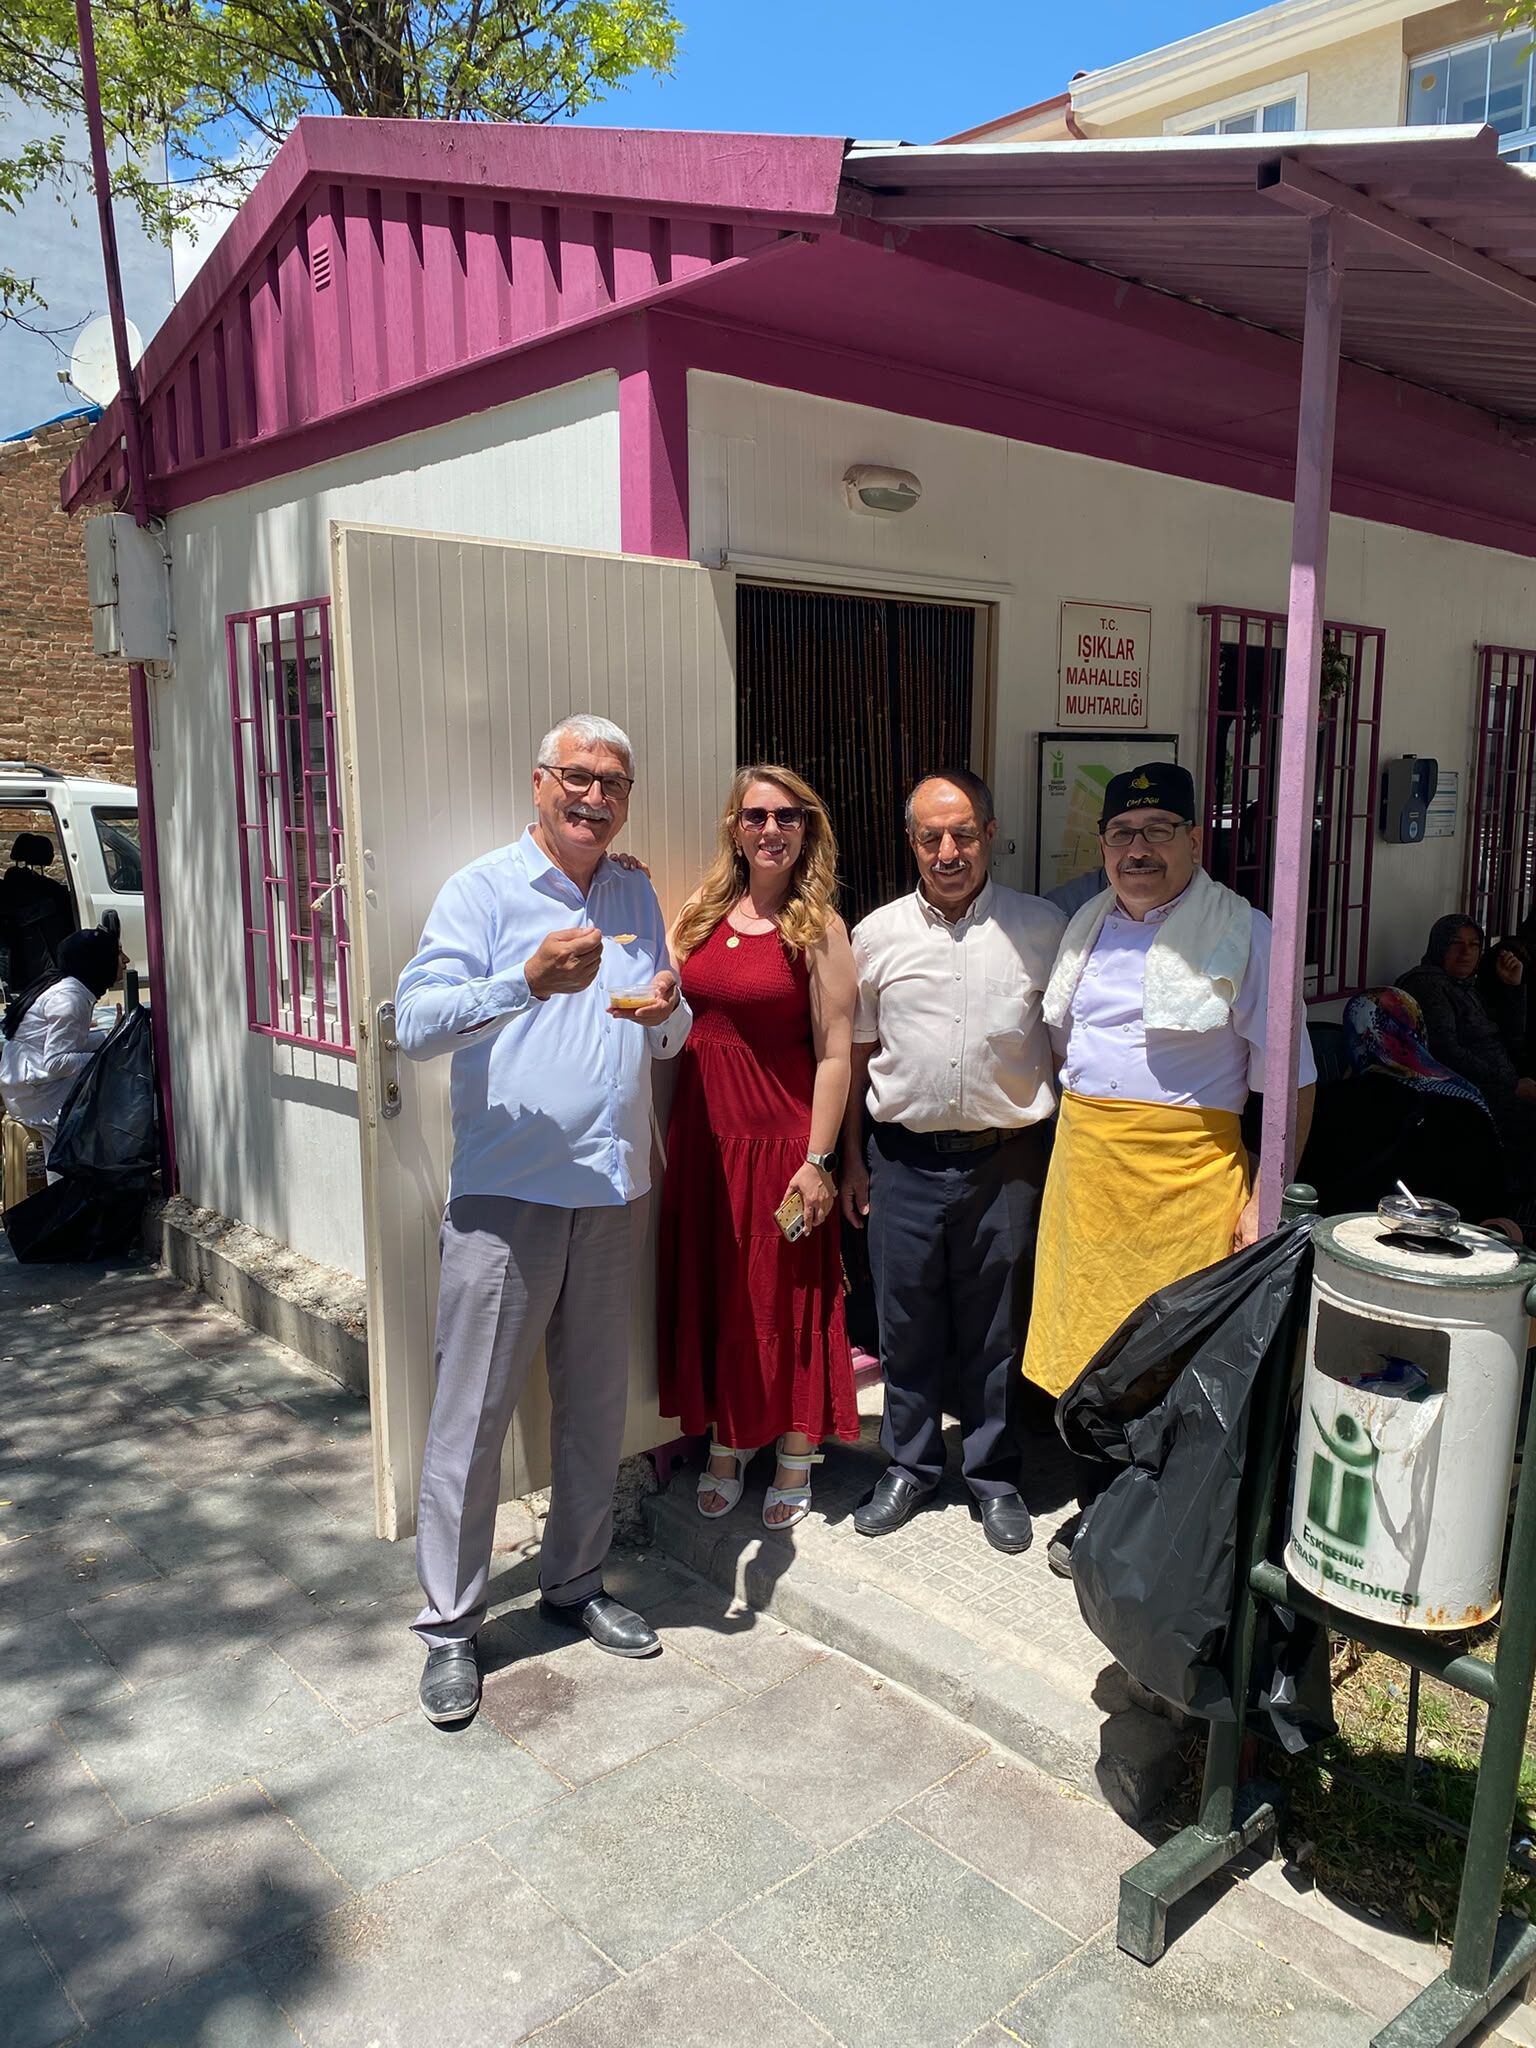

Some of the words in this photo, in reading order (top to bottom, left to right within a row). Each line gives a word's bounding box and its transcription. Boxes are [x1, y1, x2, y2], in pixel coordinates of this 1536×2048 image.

[1099, 617, 1119, 631] T.C.
[1077, 634, 1135, 663] IŞIKLAR
[1066, 667, 1142, 689] MAHALLESİ
[1066, 693, 1143, 716] MUHTARLIĞI
